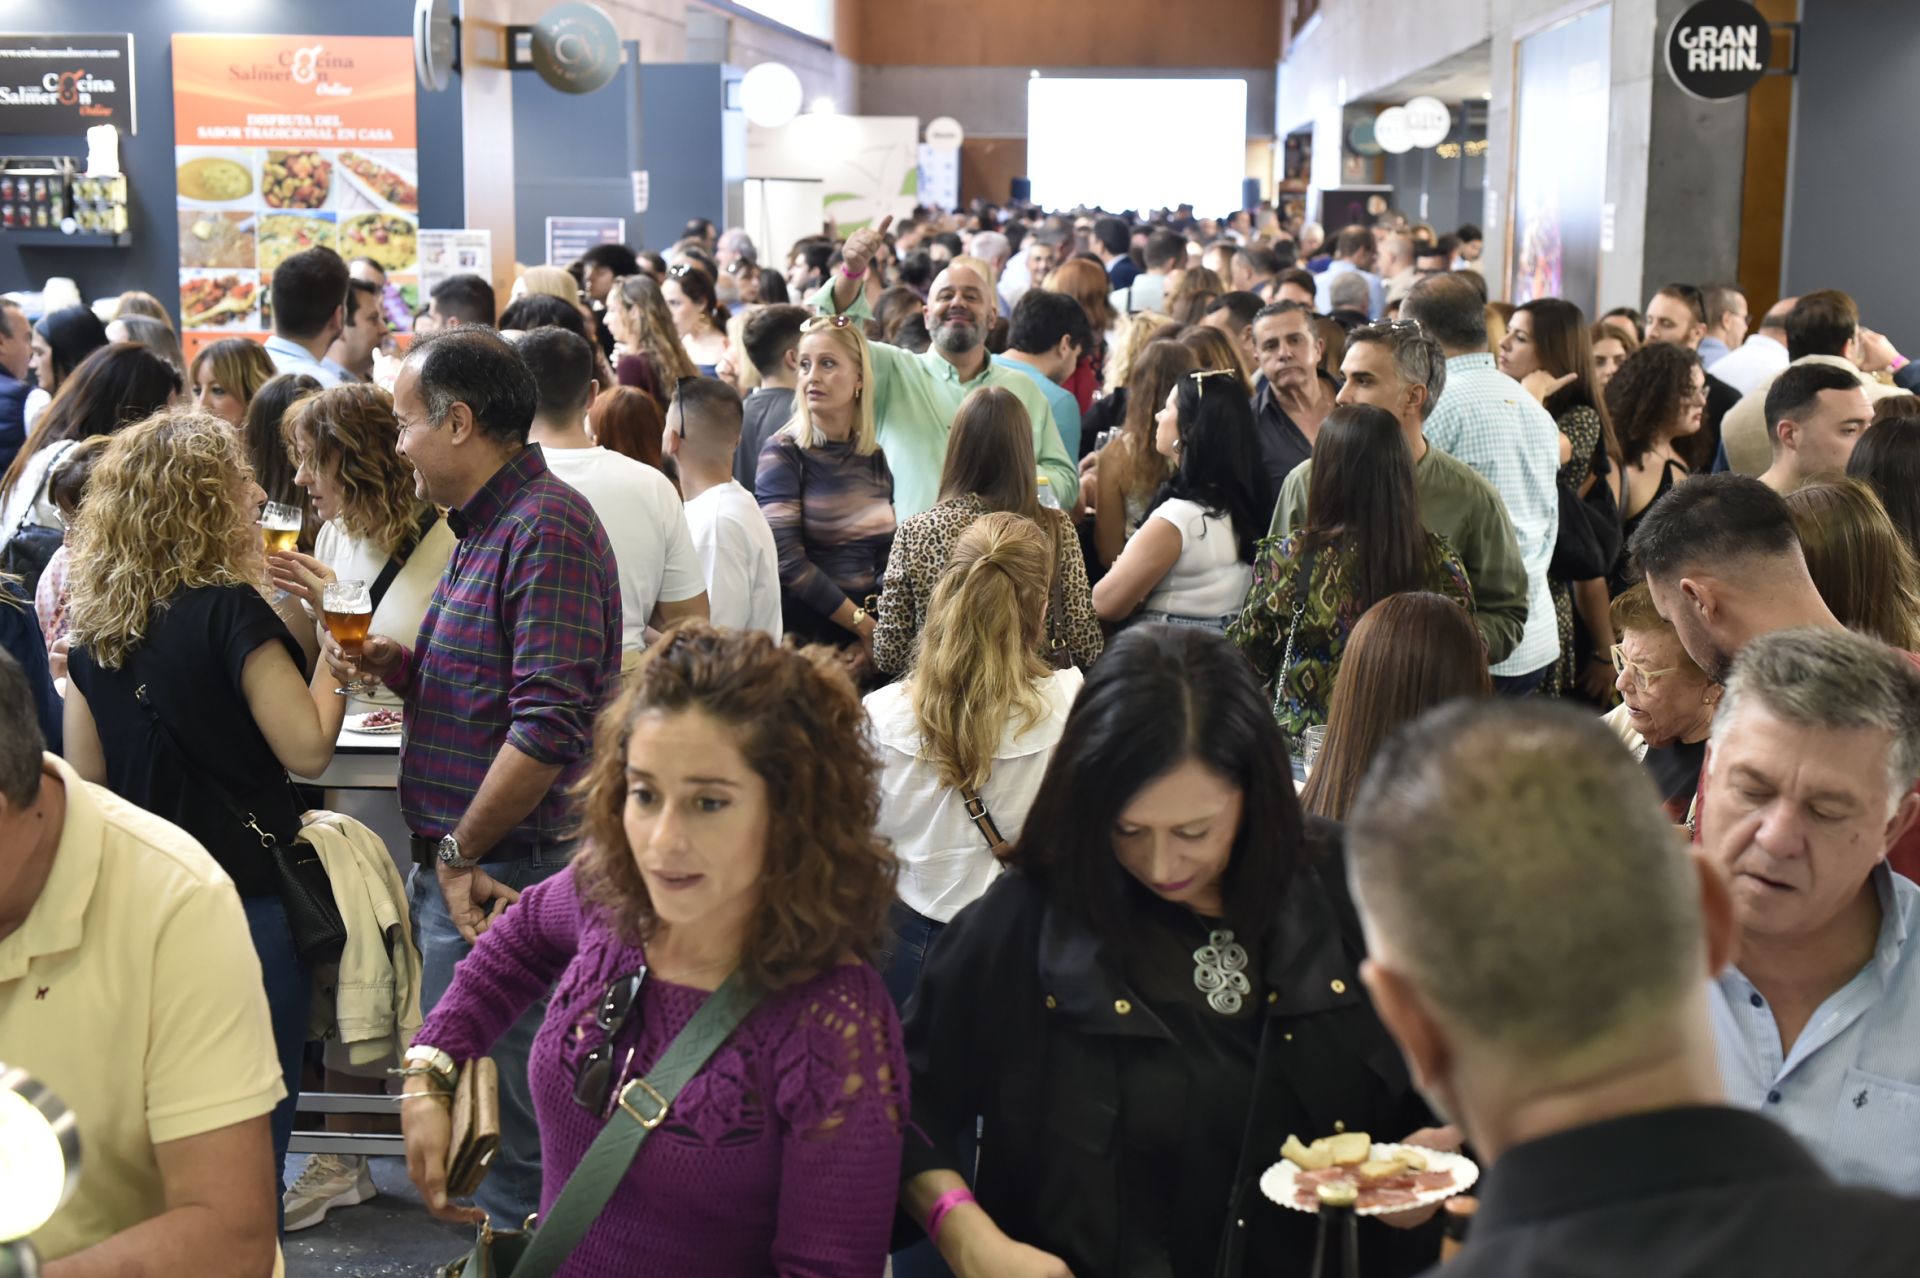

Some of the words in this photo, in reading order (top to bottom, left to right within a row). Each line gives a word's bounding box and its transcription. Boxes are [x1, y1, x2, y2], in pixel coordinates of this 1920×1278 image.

[1678, 25, 1758, 49] GRAN
[1687, 48, 1762, 72] RHIN.
[246, 113, 313, 127] DISFRUTA
[314, 114, 343, 127] DEL
[197, 126, 242, 140] SABOR
[244, 126, 334, 140] TRADICIONAL
[337, 128, 357, 141] EN
[358, 128, 394, 142] CASA
